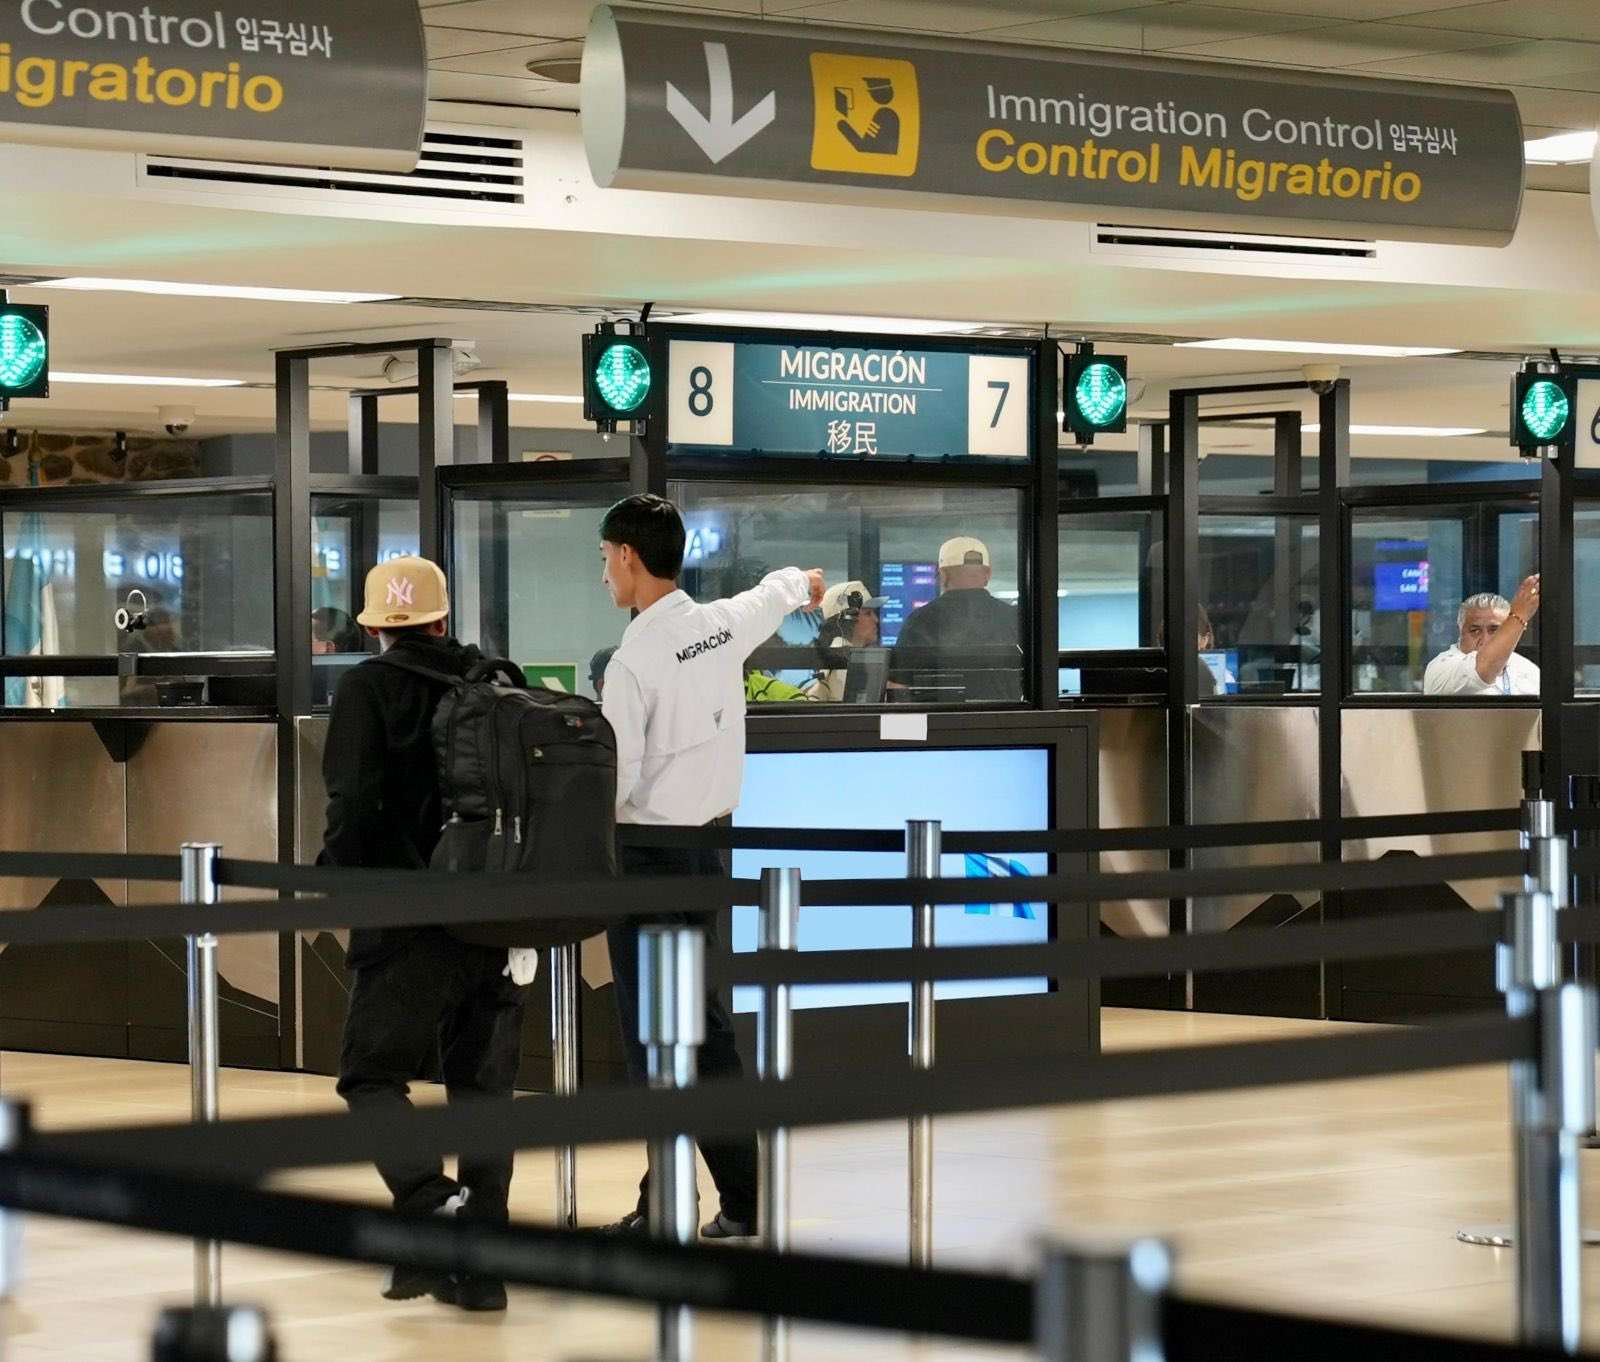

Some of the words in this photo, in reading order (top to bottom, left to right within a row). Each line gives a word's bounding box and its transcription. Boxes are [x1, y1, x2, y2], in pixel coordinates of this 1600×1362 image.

[20, 0, 225, 49] Control
[235, 17, 333, 58] 입국심사
[986, 84, 1228, 138] Immigration
[1242, 108, 1383, 150] Control
[1389, 124, 1458, 156] 입국심사
[975, 128, 1161, 184] Control
[1179, 145, 1422, 203] Migratorio
[779, 349, 926, 385] MIGRACIÓN
[687, 366, 714, 417] 8
[788, 388, 917, 415] IMMIGRATION
[986, 380, 1011, 428] 7
[826, 419, 879, 455] 移民
[676, 626, 734, 664] MIGRACIÓN
